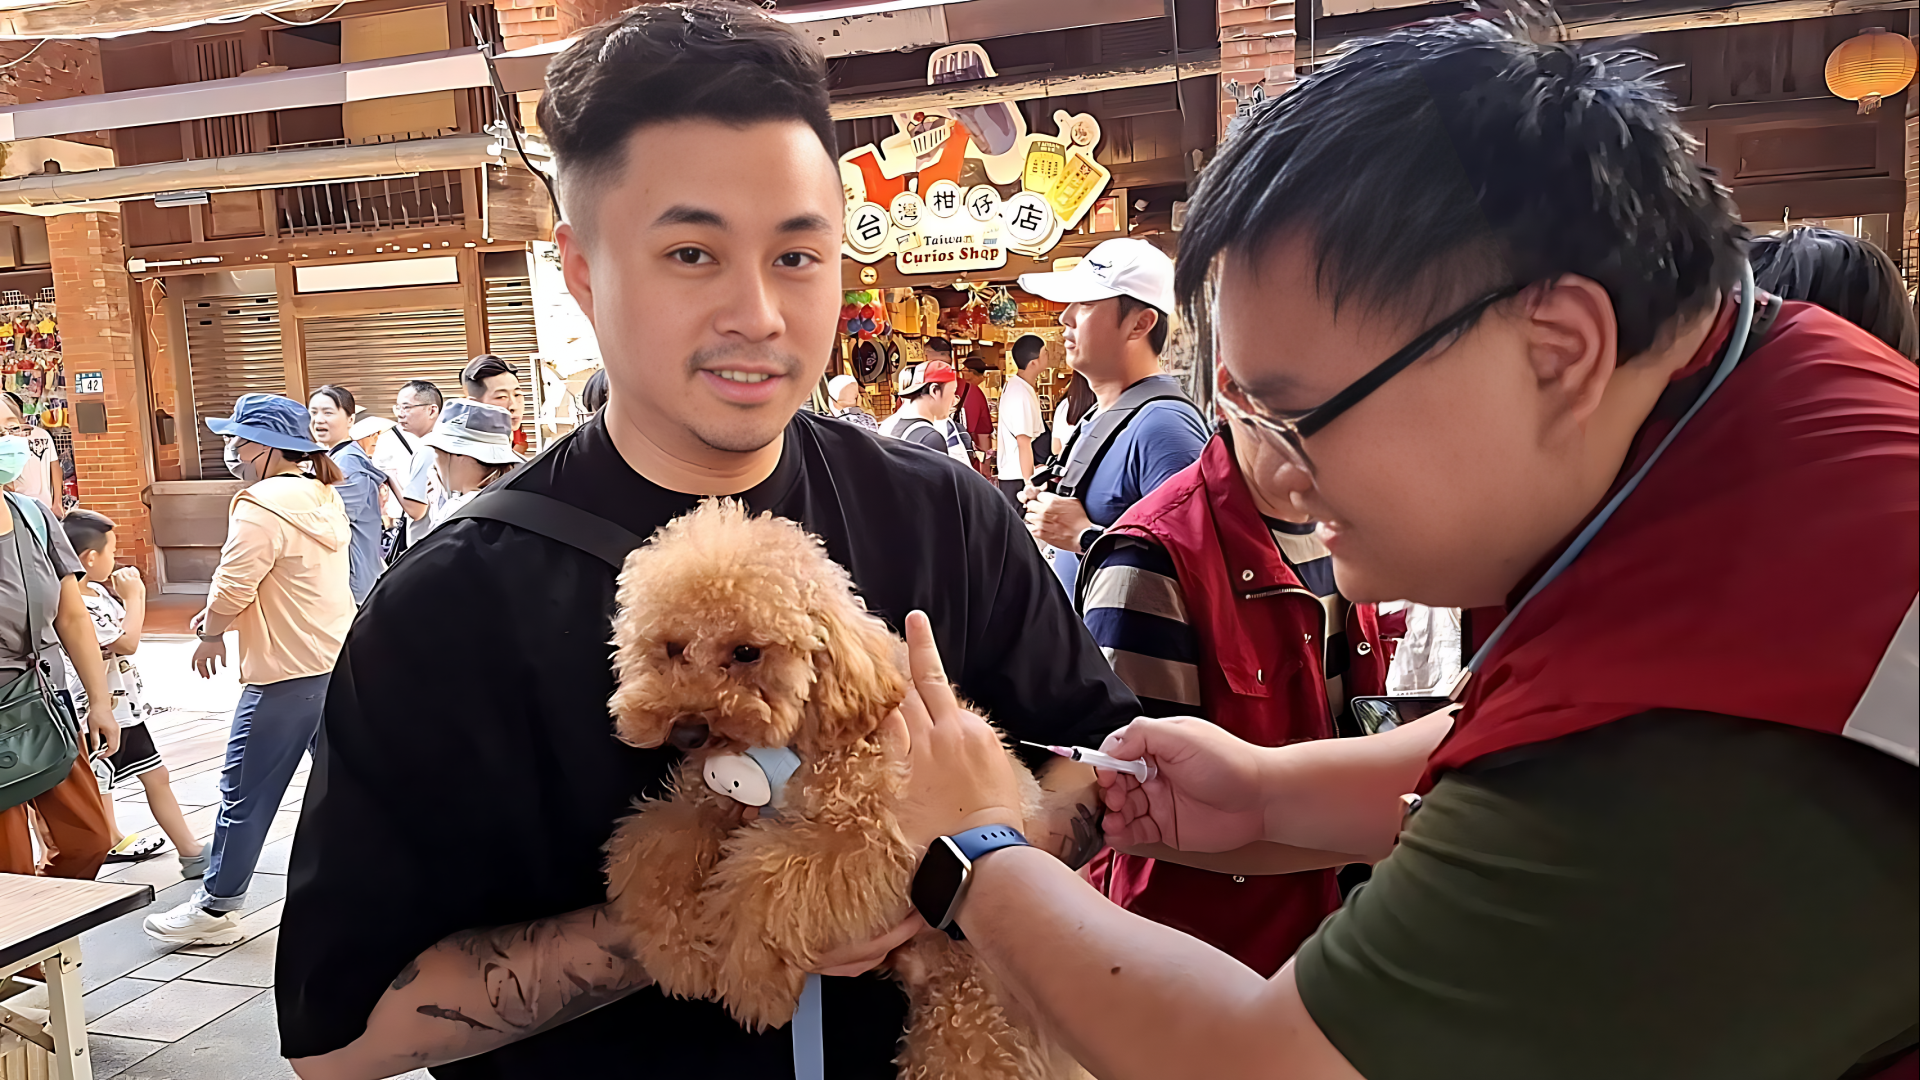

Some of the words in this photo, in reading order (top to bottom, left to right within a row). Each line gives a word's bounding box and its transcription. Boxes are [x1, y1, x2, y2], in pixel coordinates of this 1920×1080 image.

[923, 235, 974, 246] Taiwan
[903, 250, 954, 264] Curios
[959, 247, 999, 261] Shop
[87, 379, 99, 391] 42
